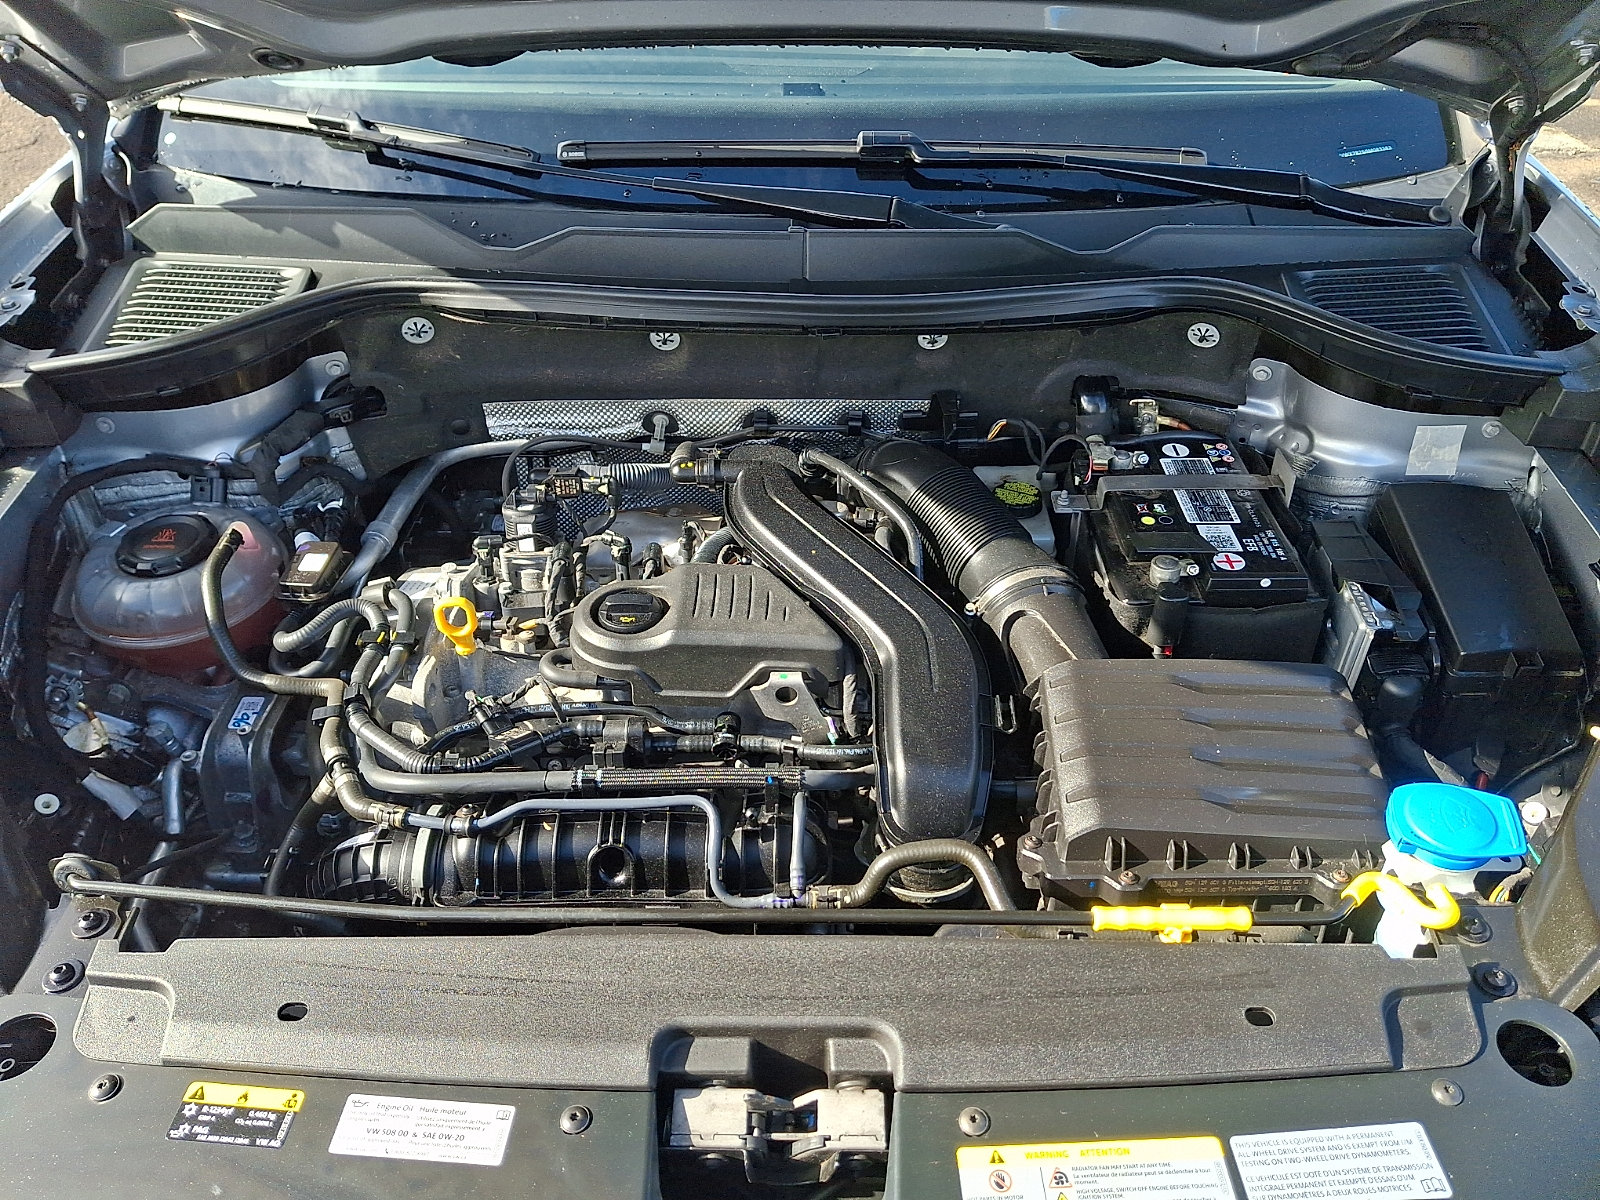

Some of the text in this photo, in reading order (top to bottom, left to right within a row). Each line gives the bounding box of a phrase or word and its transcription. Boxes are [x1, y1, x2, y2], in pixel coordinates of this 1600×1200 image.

[1242, 539, 1259, 551] EFB
[377, 1103, 401, 1112] Engine
[256, 1138, 268, 1146] VW
[438, 1133, 465, 1141] 0W-20
[1290, 1136, 1324, 1144] EQUIPPED
[1352, 1131, 1394, 1140] PERMANENT
[1352, 1141, 1378, 1149] EXEMPT
[1024, 1148, 1130, 1159] WARNING ATTENTION
[1382, 1162, 1434, 1172] TRANSMISSION
[1333, 1188, 1352, 1196] DEUX
[1353, 1186, 1376, 1195] ROUES
